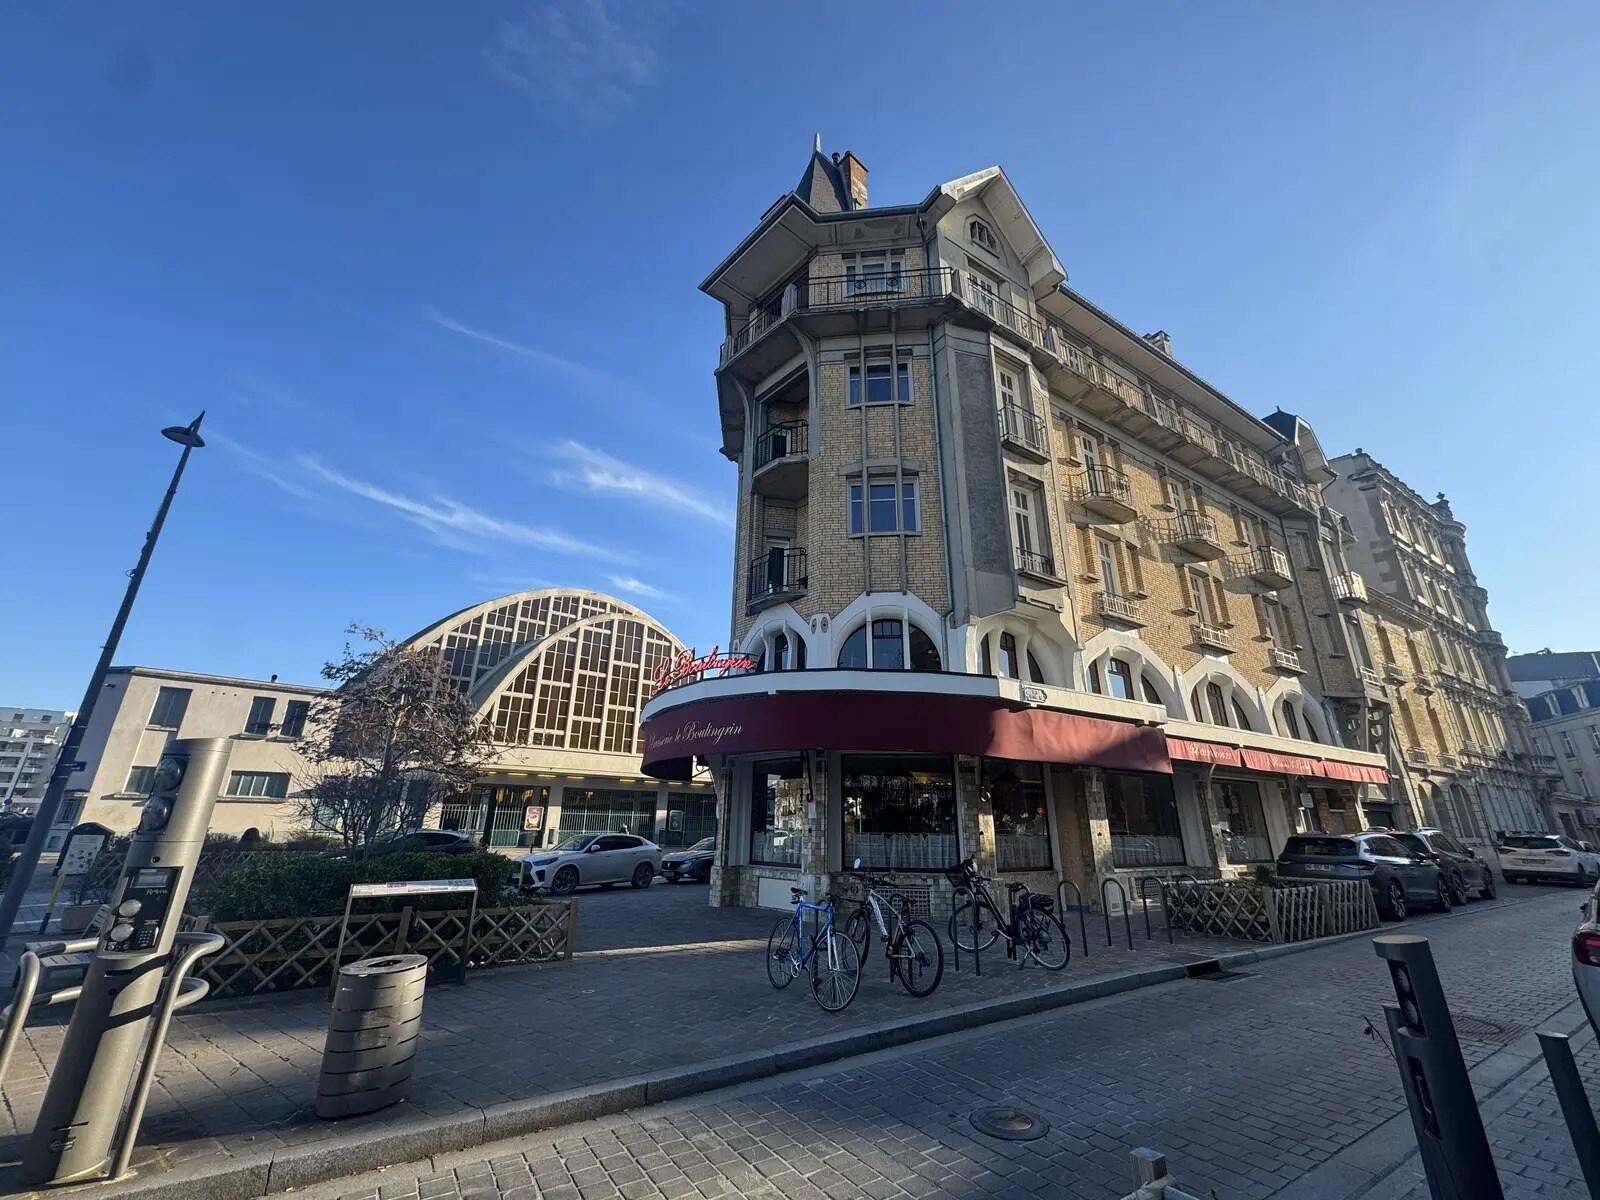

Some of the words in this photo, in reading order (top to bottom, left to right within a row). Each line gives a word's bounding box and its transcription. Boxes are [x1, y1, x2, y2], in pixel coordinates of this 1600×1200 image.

[652, 655, 671, 695] Le
[673, 646, 755, 680] Boulingrin
[682, 720, 744, 746] Boulingrin
